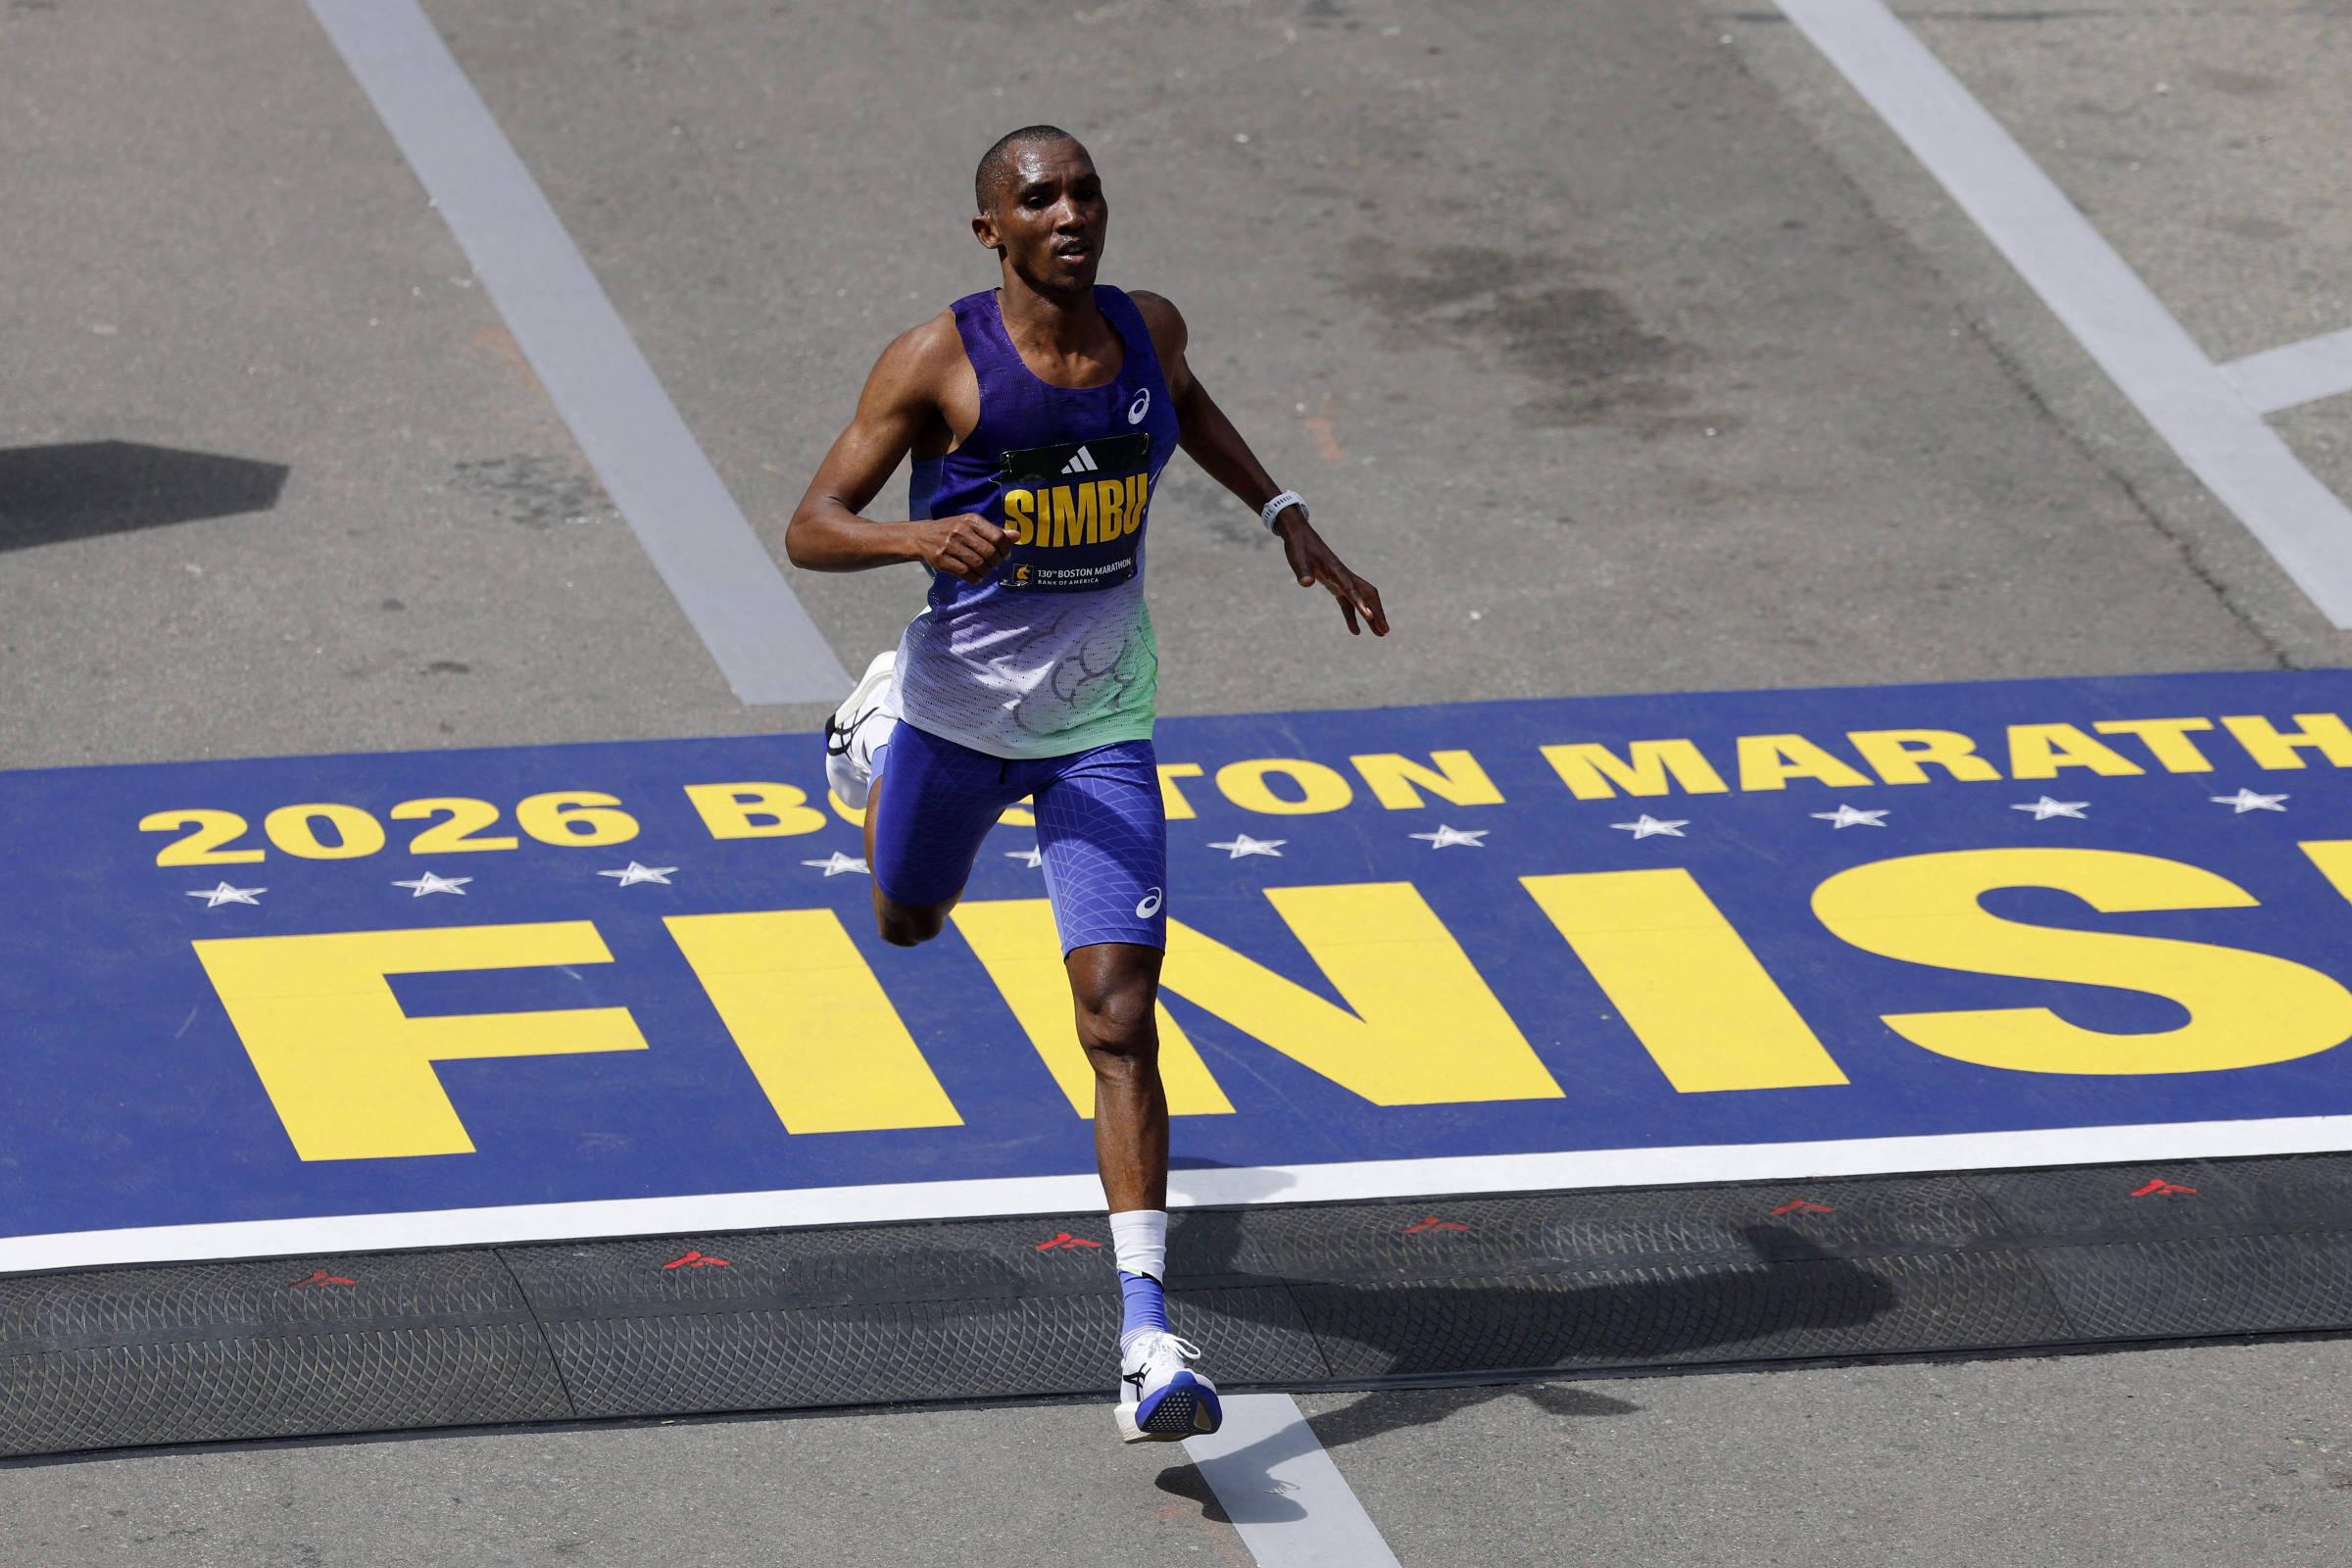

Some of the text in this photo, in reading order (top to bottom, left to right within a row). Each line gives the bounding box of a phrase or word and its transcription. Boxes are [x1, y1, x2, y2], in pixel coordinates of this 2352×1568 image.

[1004, 472, 1149, 548] SIMBU
[1057, 568, 1093, 578] BOSTON
[1094, 558, 1131, 575] MARATHON
[139, 713, 2352, 865] 2026 BON MARATH
[193, 841, 2352, 1160] FINIS
